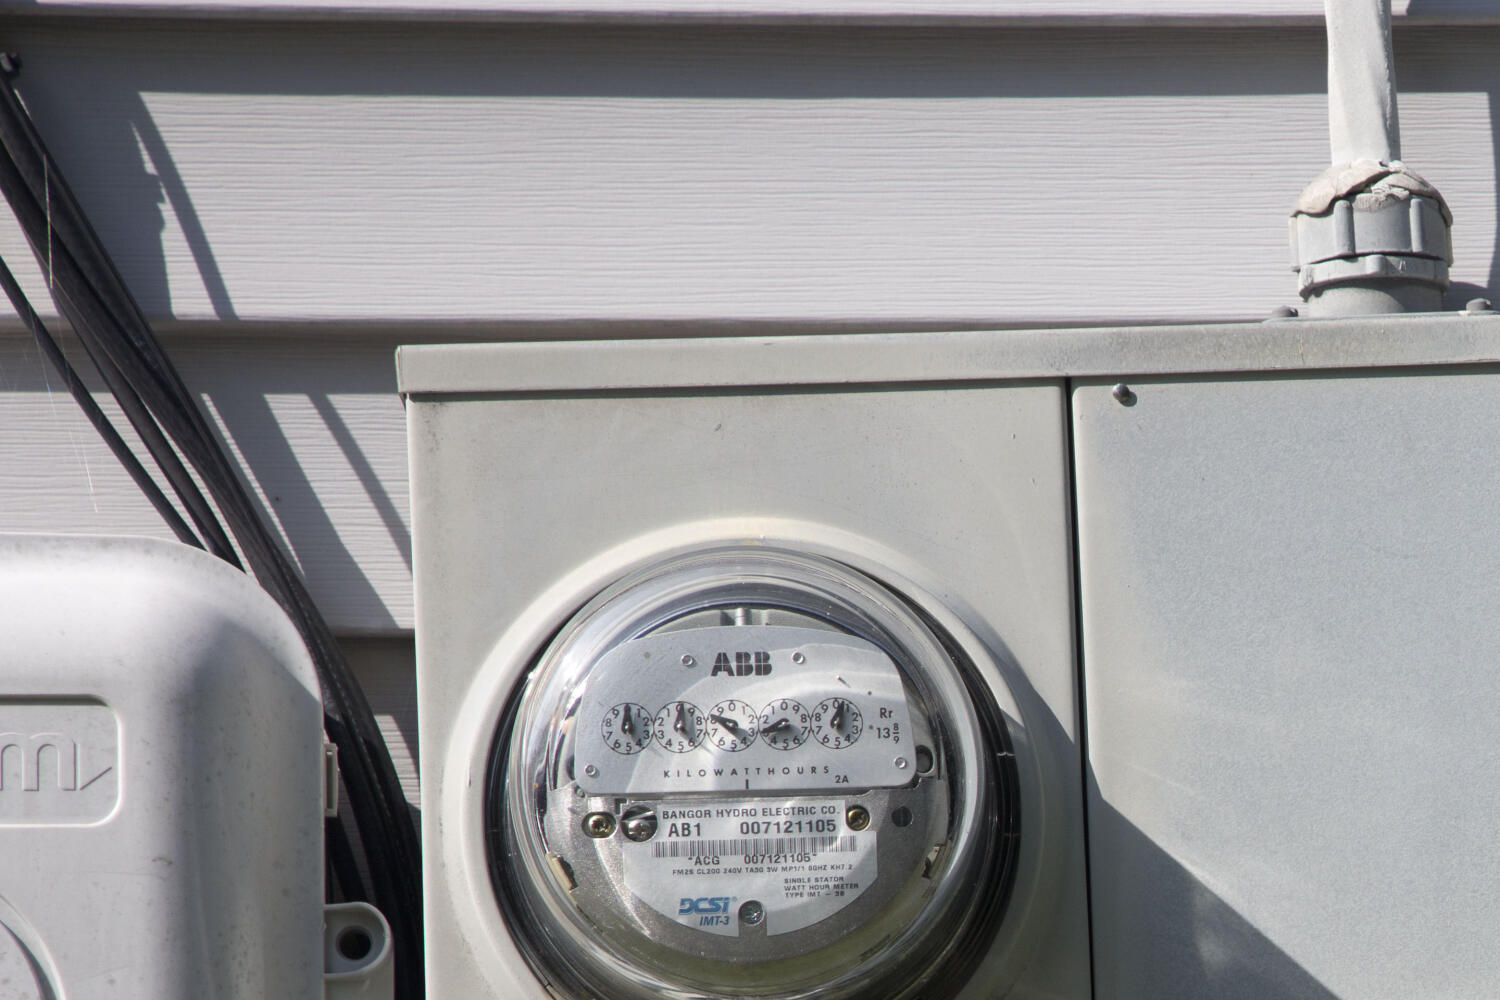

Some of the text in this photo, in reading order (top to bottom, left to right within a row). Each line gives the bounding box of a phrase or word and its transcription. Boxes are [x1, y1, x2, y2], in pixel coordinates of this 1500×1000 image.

[711, 652, 772, 676] ABB
[835, 775, 849, 783] 2A
[663, 807, 840, 819] BANGOR HYDRO ELECTRIC CO.
[669, 820, 836, 837] AB1 007121105
[700, 915, 729, 926] IMT-3
